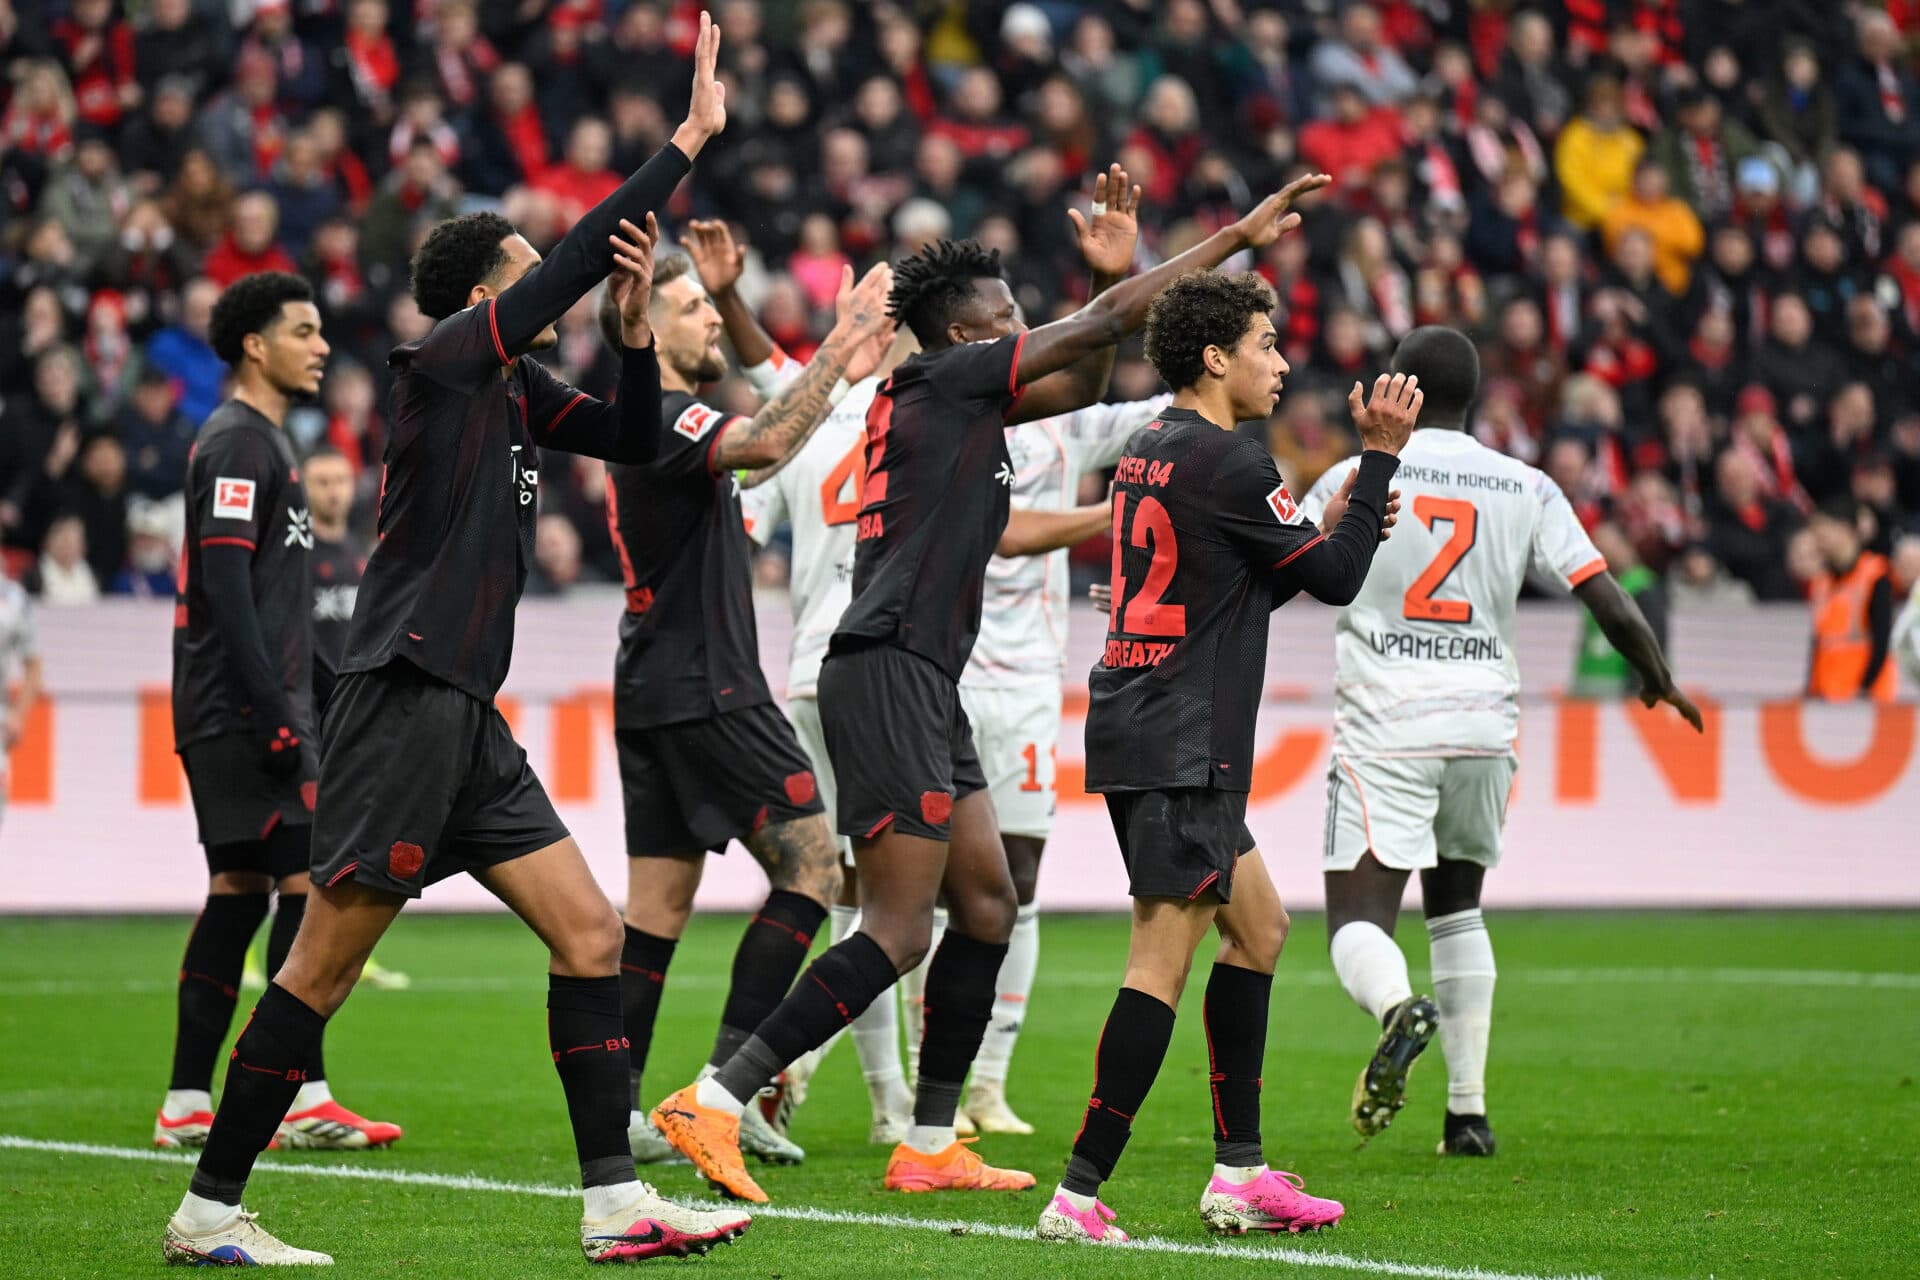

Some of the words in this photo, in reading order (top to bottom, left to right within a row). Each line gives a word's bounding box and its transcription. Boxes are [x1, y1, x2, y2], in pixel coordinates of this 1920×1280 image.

[1147, 460, 1175, 487] 04
[1457, 472, 1523, 494] MÜNCHEN
[1403, 495, 1478, 623] 2
